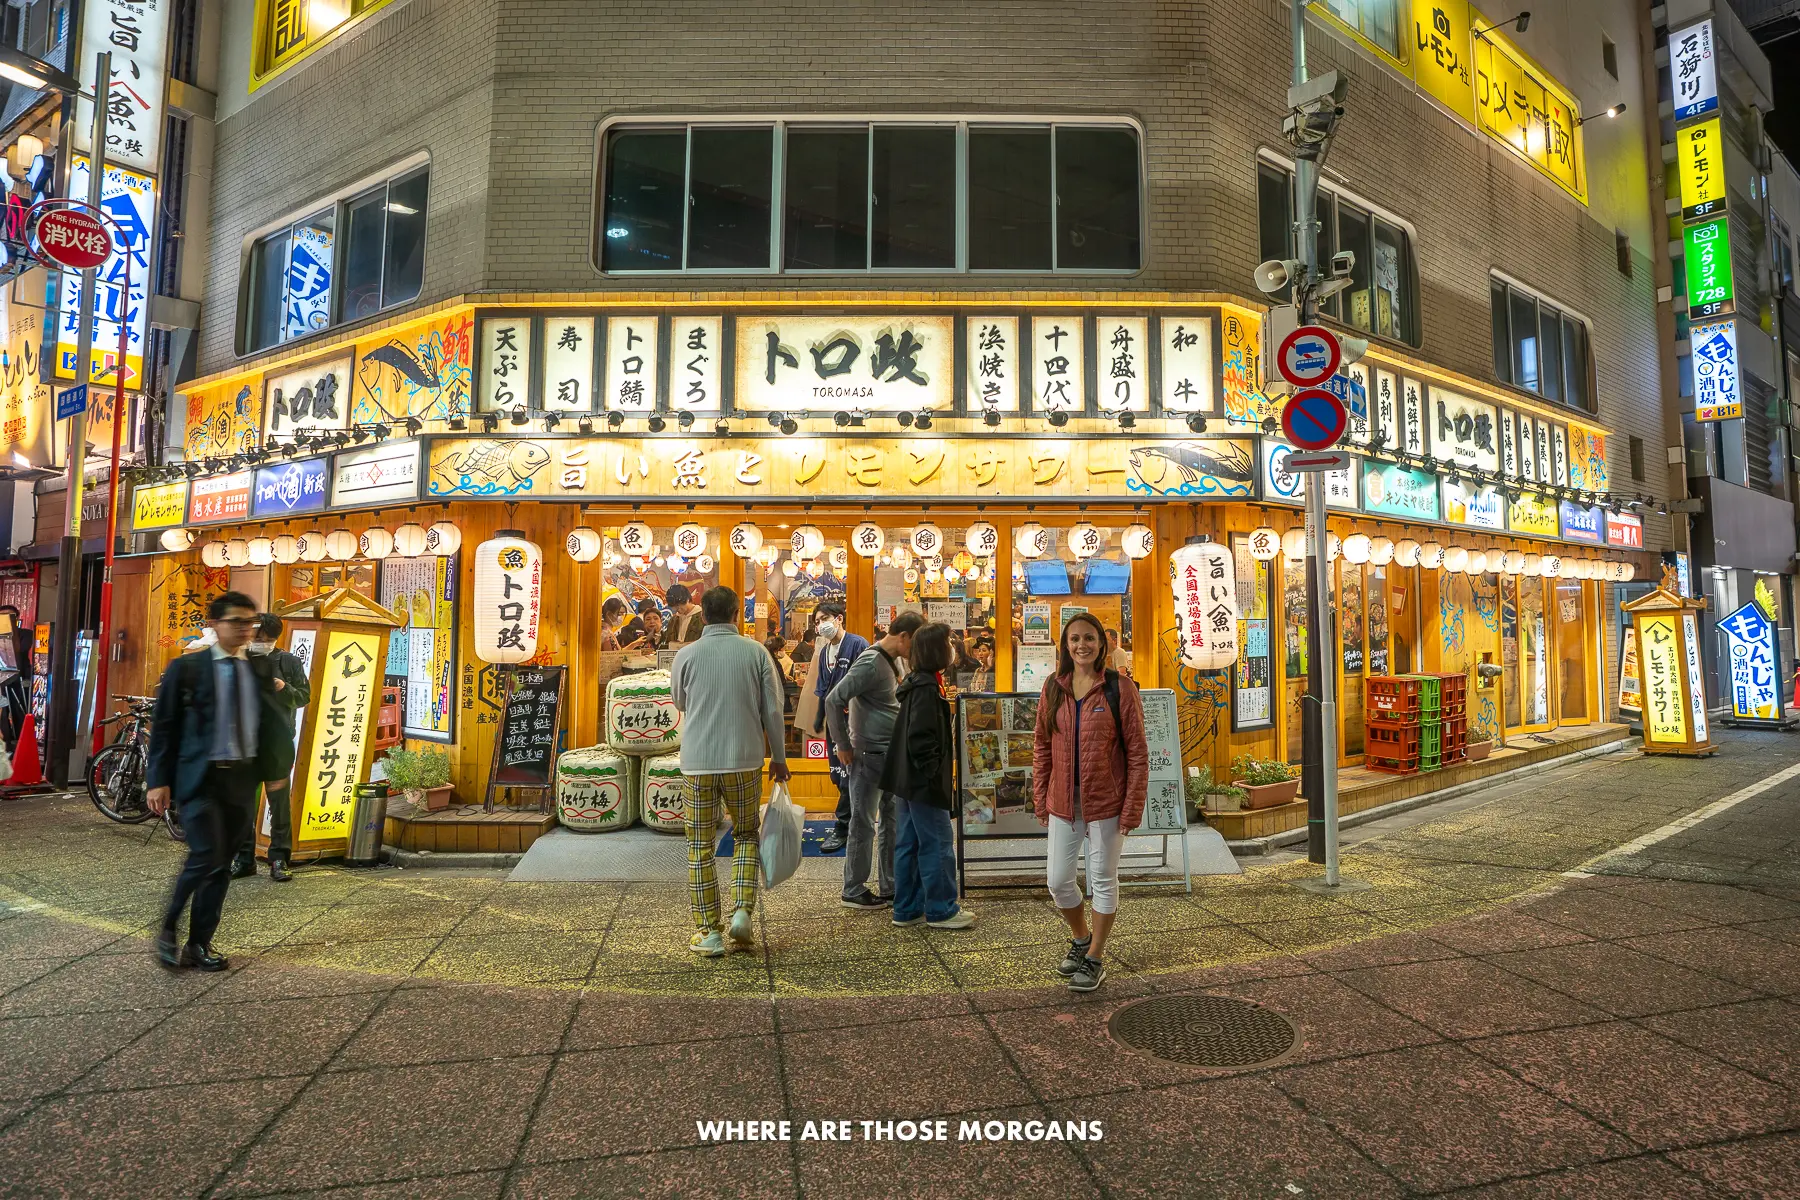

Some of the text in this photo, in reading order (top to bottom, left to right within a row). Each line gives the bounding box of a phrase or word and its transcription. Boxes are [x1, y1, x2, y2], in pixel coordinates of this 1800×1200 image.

[1416, 22, 1469, 86] レモン社
[1675, 33, 1701, 100] 石狩川
[1686, 101, 1706, 116] 4F
[1694, 143, 1709, 199] レモン社
[51, 213, 101, 231] FIRE HYDRANT
[1695, 201, 1713, 215] 3F
[44, 221, 107, 256] 消火栓
[1700, 242, 1716, 287] スタジオ
[1696, 286, 1726, 303] 728
[1703, 302, 1721, 315] 3F
[1228, 320, 1239, 340] 貝
[63, 351, 101, 374] BF
[494, 327, 518, 405] 天ぷら
[557, 326, 582, 404] 寿司
[620, 327, 645, 406] トロ鯖
[686, 327, 709, 403] まぐろ
[765, 329, 929, 388] トロ政
[978, 325, 1005, 404] 浜焼き
[1043, 325, 1071, 405] 十四代
[1110, 325, 1136, 405] 舟盛り
[1171, 325, 1198, 404] 和牛
[271, 373, 339, 431] トロ政
[813, 387, 874, 398] TOROMASA
[1699, 376, 1716, 404] 酒場
[1380, 378, 1392, 442] 馬刺し
[1407, 386, 1419, 450] 海鮮丼
[1437, 400, 1496, 455] トロ政
[1717, 405, 1737, 417] B1F
[303, 472, 326, 495] 新政
[558, 449, 1126, 490] 旨い魚とレモンサワー
[150, 504, 184, 518] レモンサワー
[193, 496, 223, 518] 旭水産
[1522, 513, 1556, 526] レモンサワー
[623, 527, 643, 549] 魚
[731, 527, 747, 550] 魚
[859, 527, 879, 549] 魚
[980, 527, 997, 550] 魚
[1083, 528, 1099, 550] 魚
[1253, 532, 1271, 554] 魚
[505, 549, 524, 569] 魚
[168, 592, 178, 630] 厳選産地
[180, 588, 204, 629] 大漁
[496, 573, 526, 651] トロ政
[1184, 564, 1204, 648] 全国漁場直送
[1208, 557, 1232, 633] 旨い魚
[463, 662, 474, 710] 全国漁連
[1650, 649, 1668, 723] レモンサワー
[616, 709, 673, 729] 松竹梅
[317, 685, 348, 808] レモンサワー
[340, 683, 367, 804] エリア最大級、専門店の味
[560, 787, 611, 809] 松竹梅
[307, 810, 346, 826] トロ政
